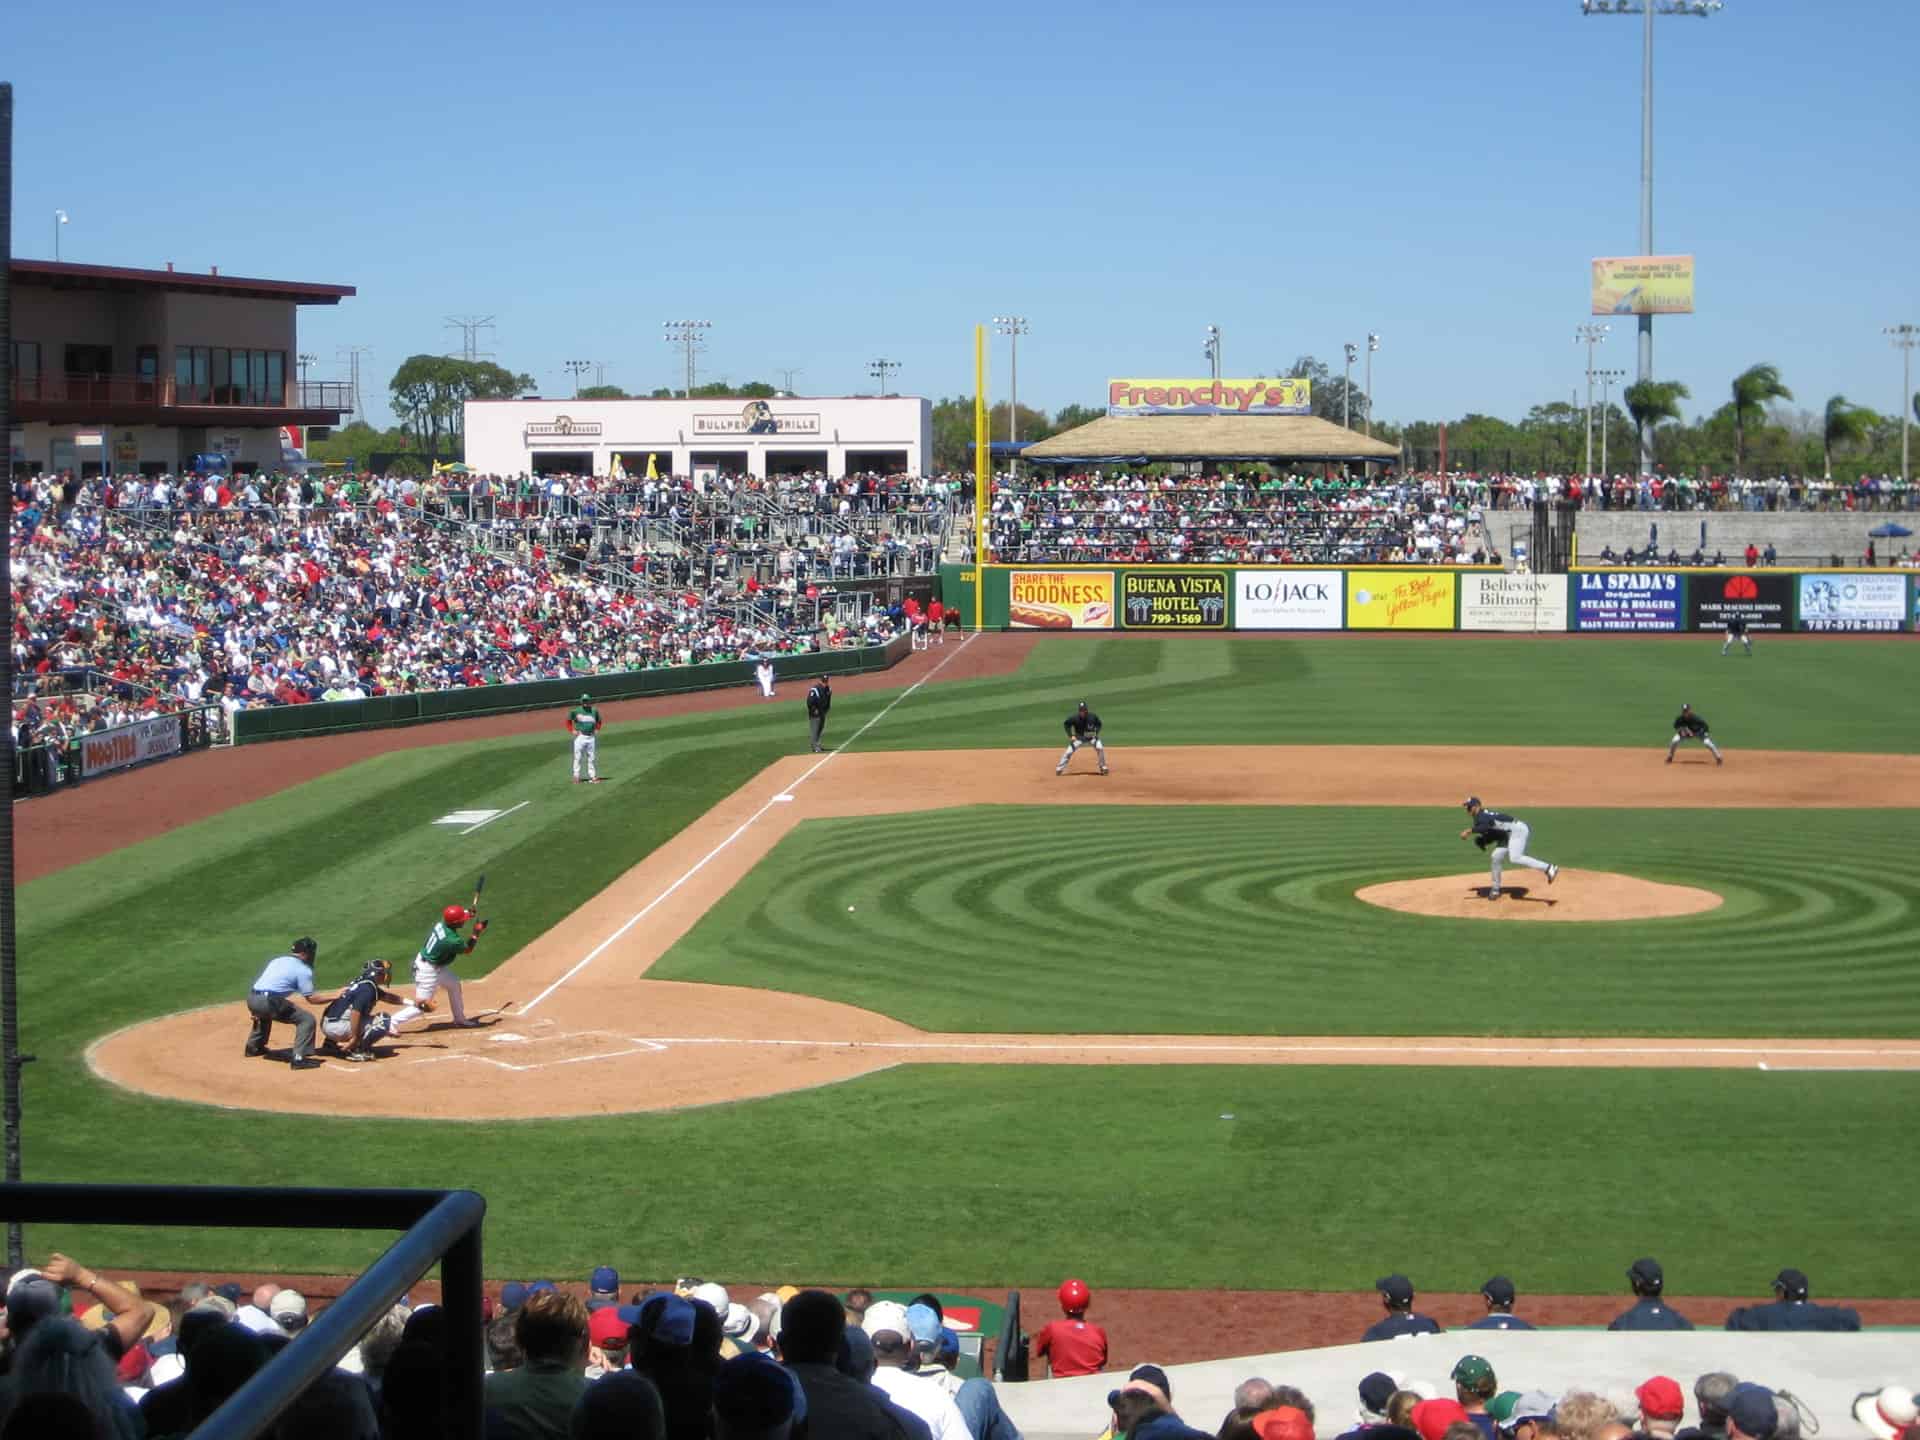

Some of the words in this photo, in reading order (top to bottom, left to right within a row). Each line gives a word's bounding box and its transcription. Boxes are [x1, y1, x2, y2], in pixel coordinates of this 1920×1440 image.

[1110, 381, 1283, 411] Frenchy's
[698, 419, 747, 430] BULLPEN
[1013, 574, 1044, 585] SHARE
[1047, 574, 1065, 585] THE
[1127, 577, 1175, 593] BUENA
[1180, 576, 1223, 593] VISTA
[1581, 574, 1603, 590] LA
[1608, 574, 1676, 590] SPADA'S
[1605, 591, 1651, 599] Original
[1153, 597, 1199, 611] HOTEL
[1580, 600, 1618, 609] STEAKS
[1621, 600, 1629, 609] &
[1631, 600, 1676, 609] HOAGIES
[1151, 613, 1201, 624] 799-1569
[1604, 621, 1635, 629] STREET
